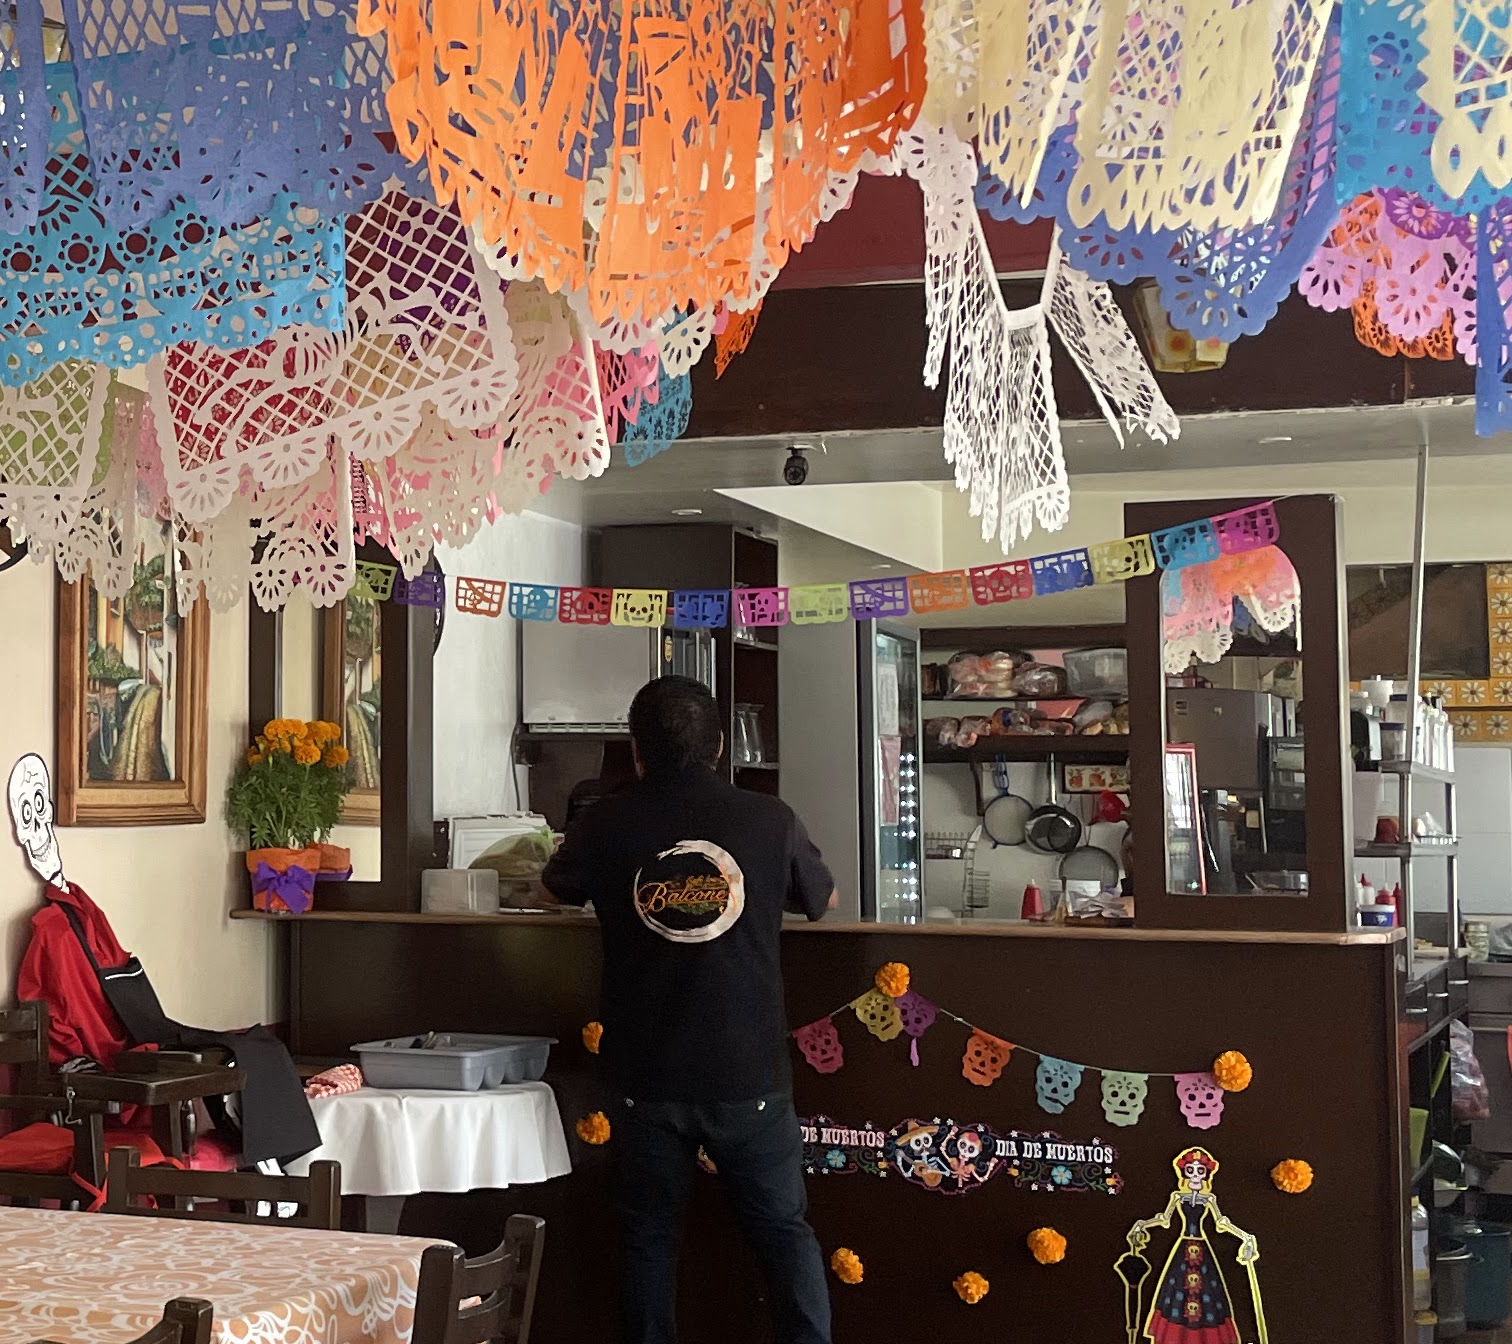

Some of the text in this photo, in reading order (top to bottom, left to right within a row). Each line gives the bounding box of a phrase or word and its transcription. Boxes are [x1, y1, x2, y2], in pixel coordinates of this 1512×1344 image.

[821, 1128, 885, 1147] MUERTOS
[995, 1140, 1113, 1163] DIA DE MUERTOS
